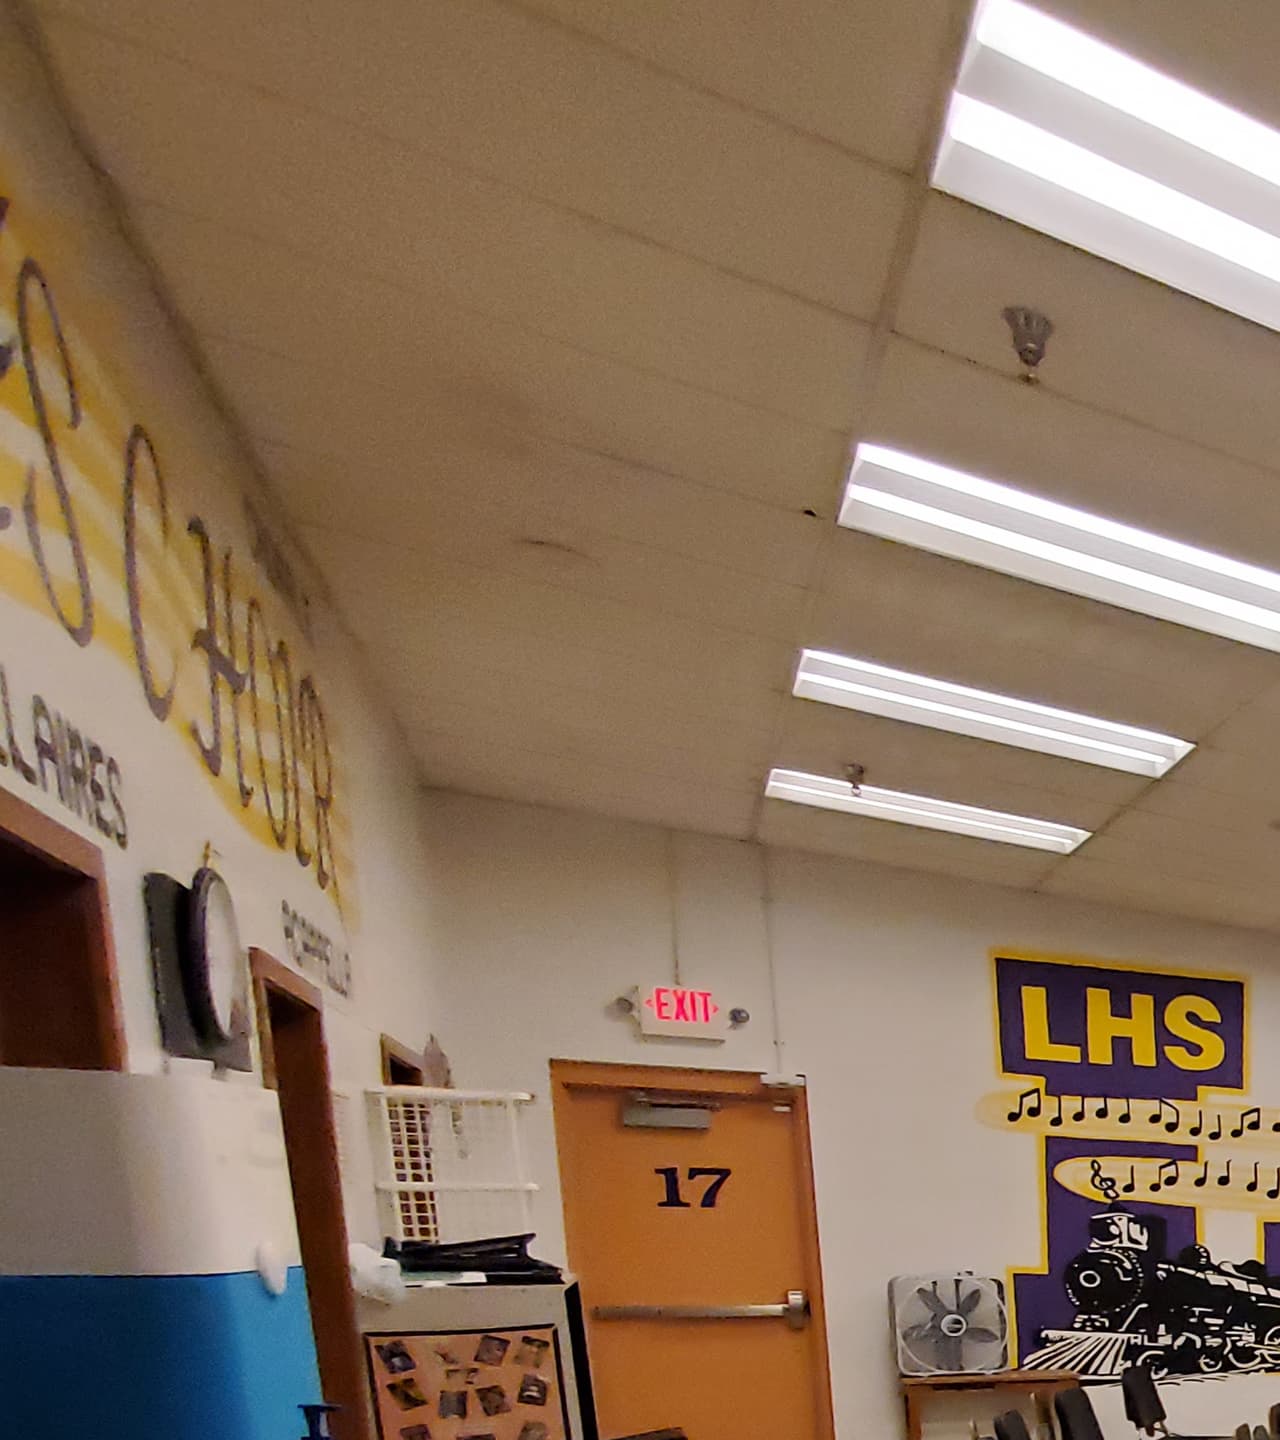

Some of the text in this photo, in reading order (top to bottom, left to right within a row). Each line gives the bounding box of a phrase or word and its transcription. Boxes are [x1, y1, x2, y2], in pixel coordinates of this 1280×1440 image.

[0, 662, 128, 850] LAIRES
[655, 987, 712, 1023] EXIT
[1020, 985, 1226, 1072] LHS
[654, 1166, 732, 1208] 17
